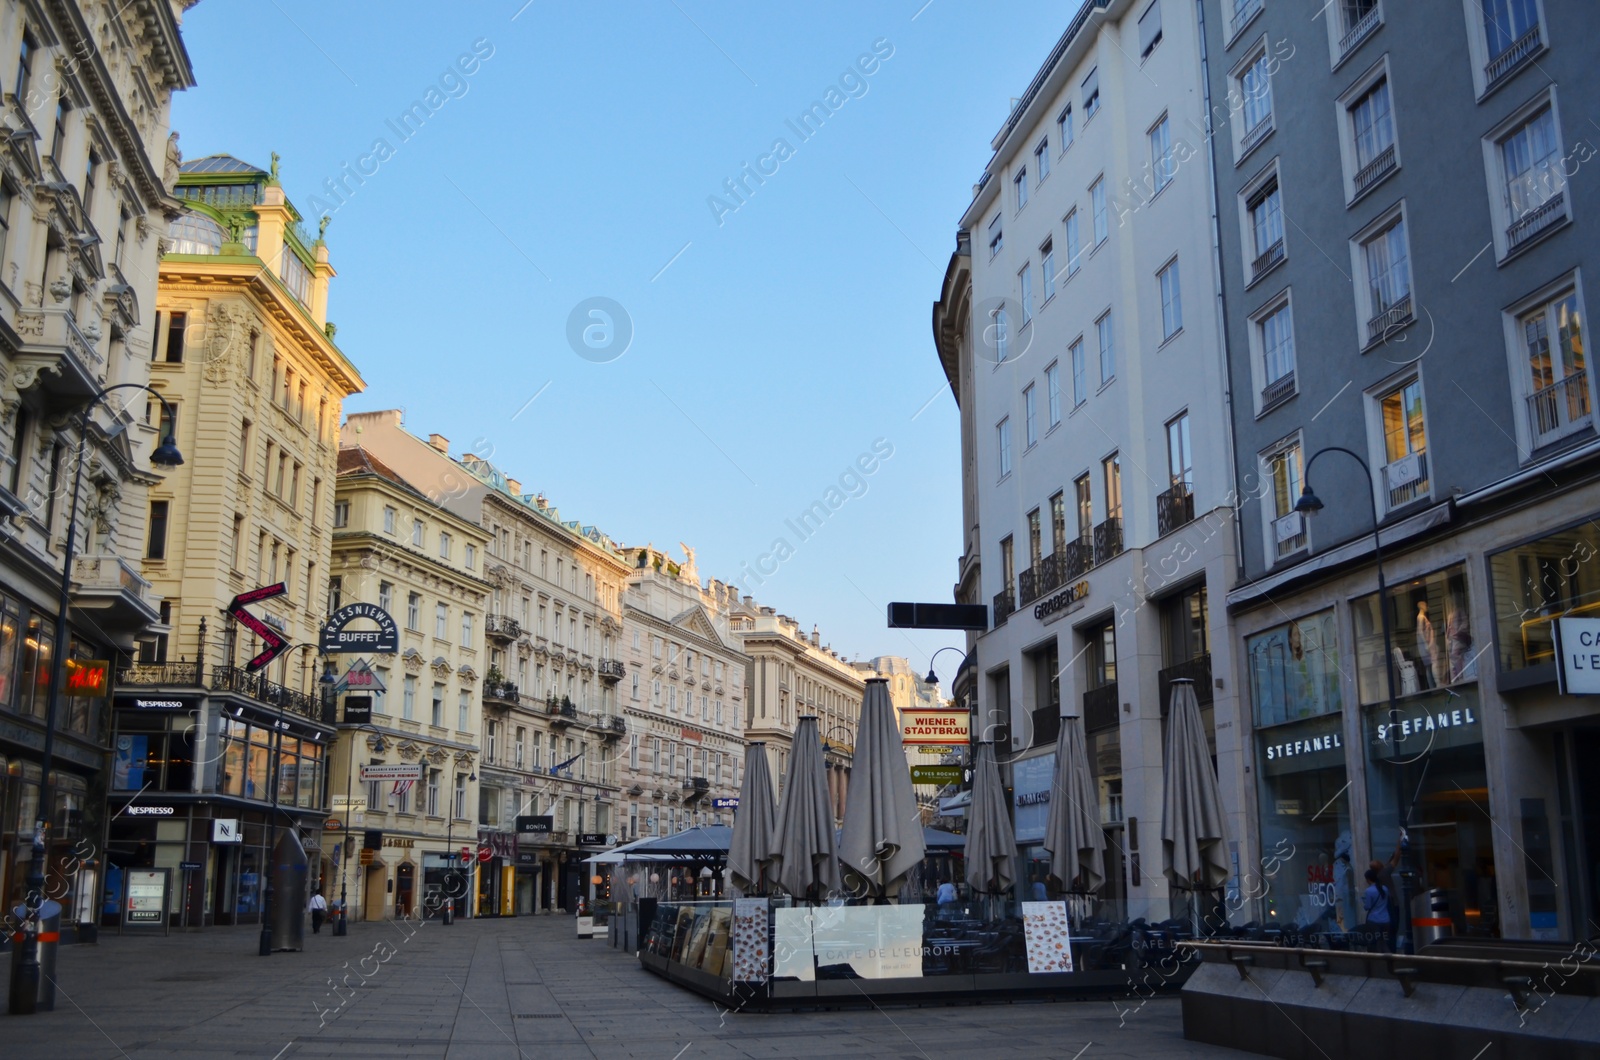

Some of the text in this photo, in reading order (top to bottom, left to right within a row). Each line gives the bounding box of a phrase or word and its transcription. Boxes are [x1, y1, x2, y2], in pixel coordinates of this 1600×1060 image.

[326, 605, 394, 639] TRZESNIEWSKI
[339, 633, 381, 642] BUFFET
[136, 699, 183, 708] NESPRESSO
[915, 718, 956, 726] WIENER
[1377, 708, 1474, 740] SEFANEL
[1266, 733, 1341, 760] STEFANEL
[128, 805, 174, 815] NESPRESSO
[525, 823, 547, 831] BONITA
[868, 948, 886, 959] DE
[892, 945, 960, 958] L'EUROPE
